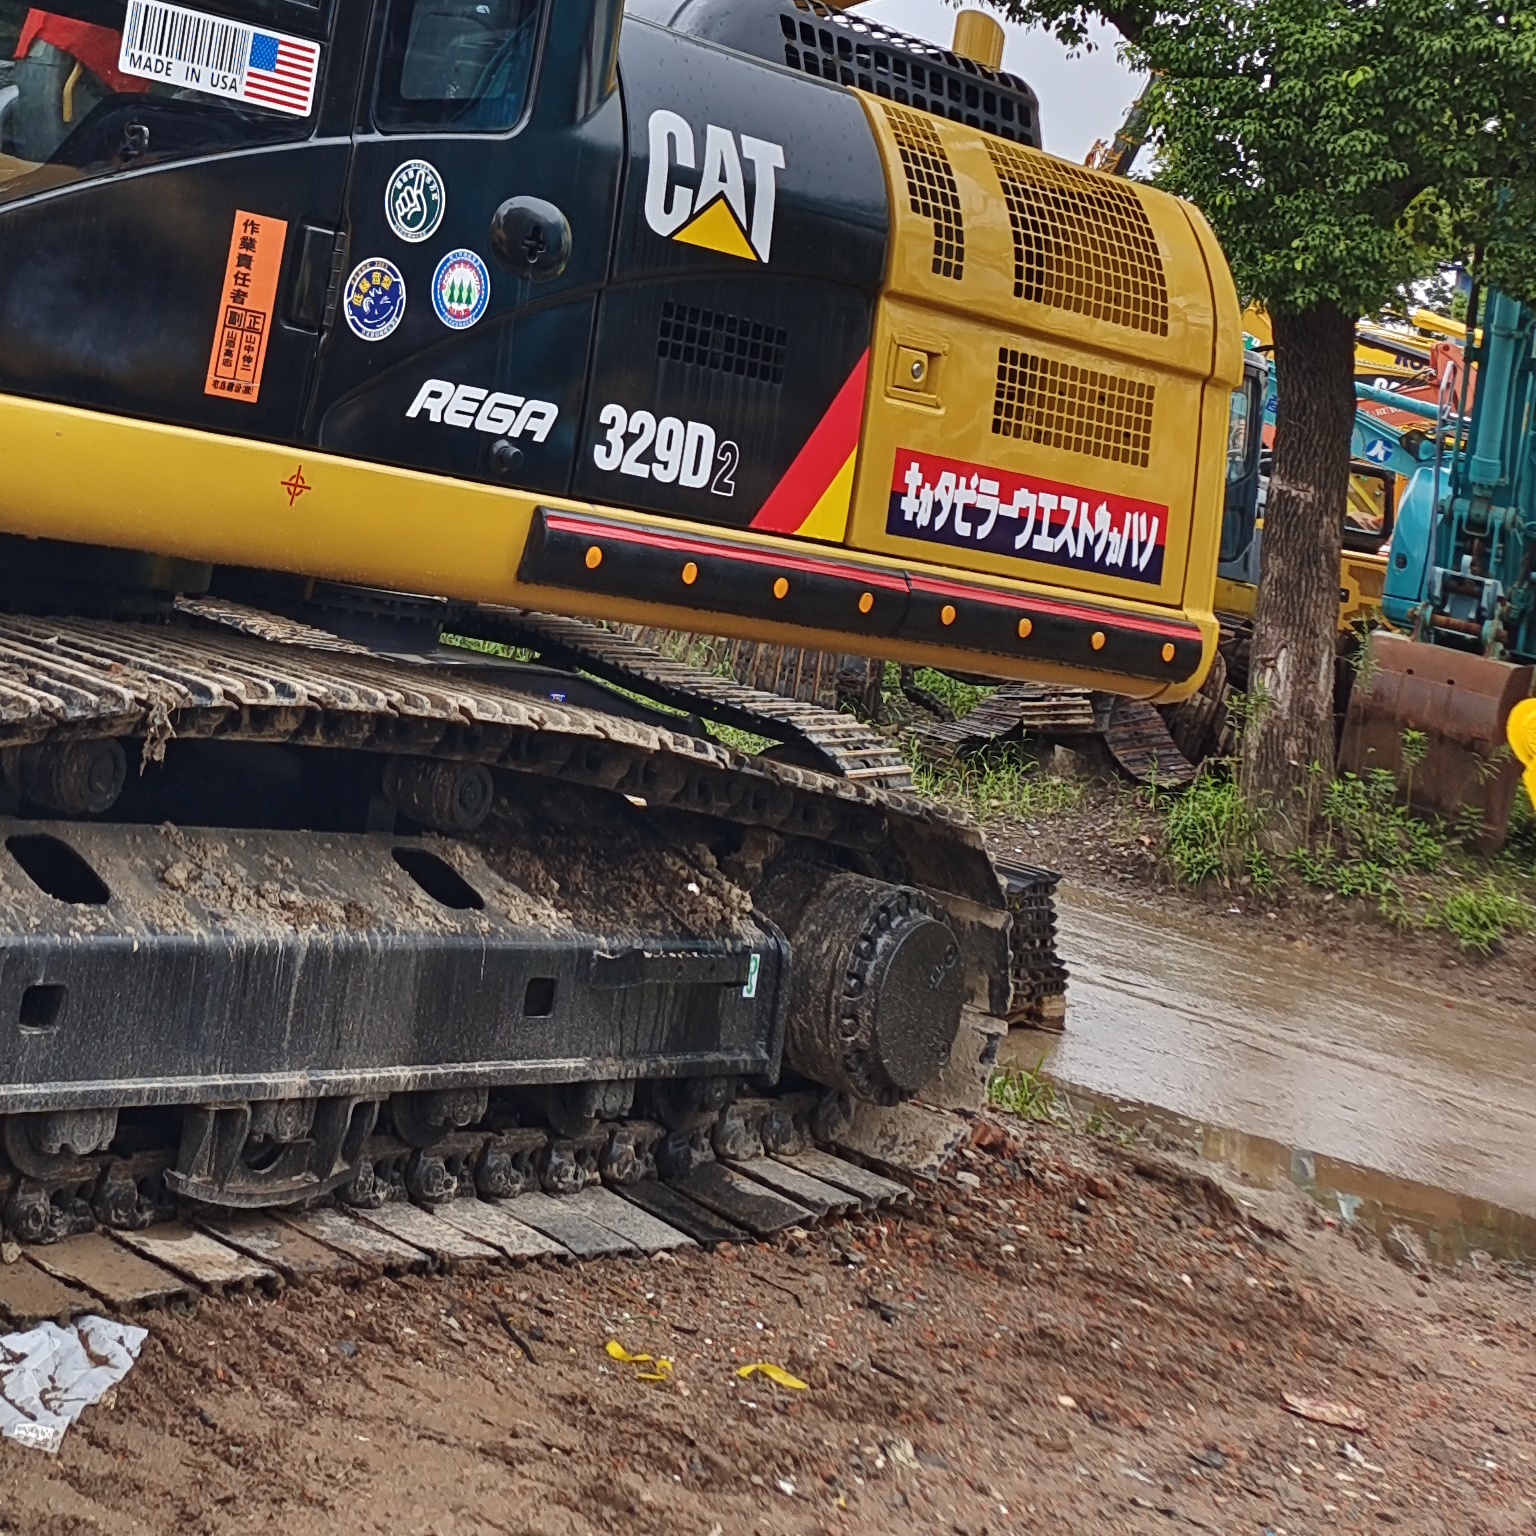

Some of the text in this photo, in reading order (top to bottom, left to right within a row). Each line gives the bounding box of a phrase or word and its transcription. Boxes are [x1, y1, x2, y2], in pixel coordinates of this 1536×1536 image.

[129, 52, 239, 94] MADE IN USA
[645, 109, 786, 263] CAT
[230, 218, 261, 306] 作業責任者
[246, 314, 262, 331] 正
[405, 377, 559, 443] REGA
